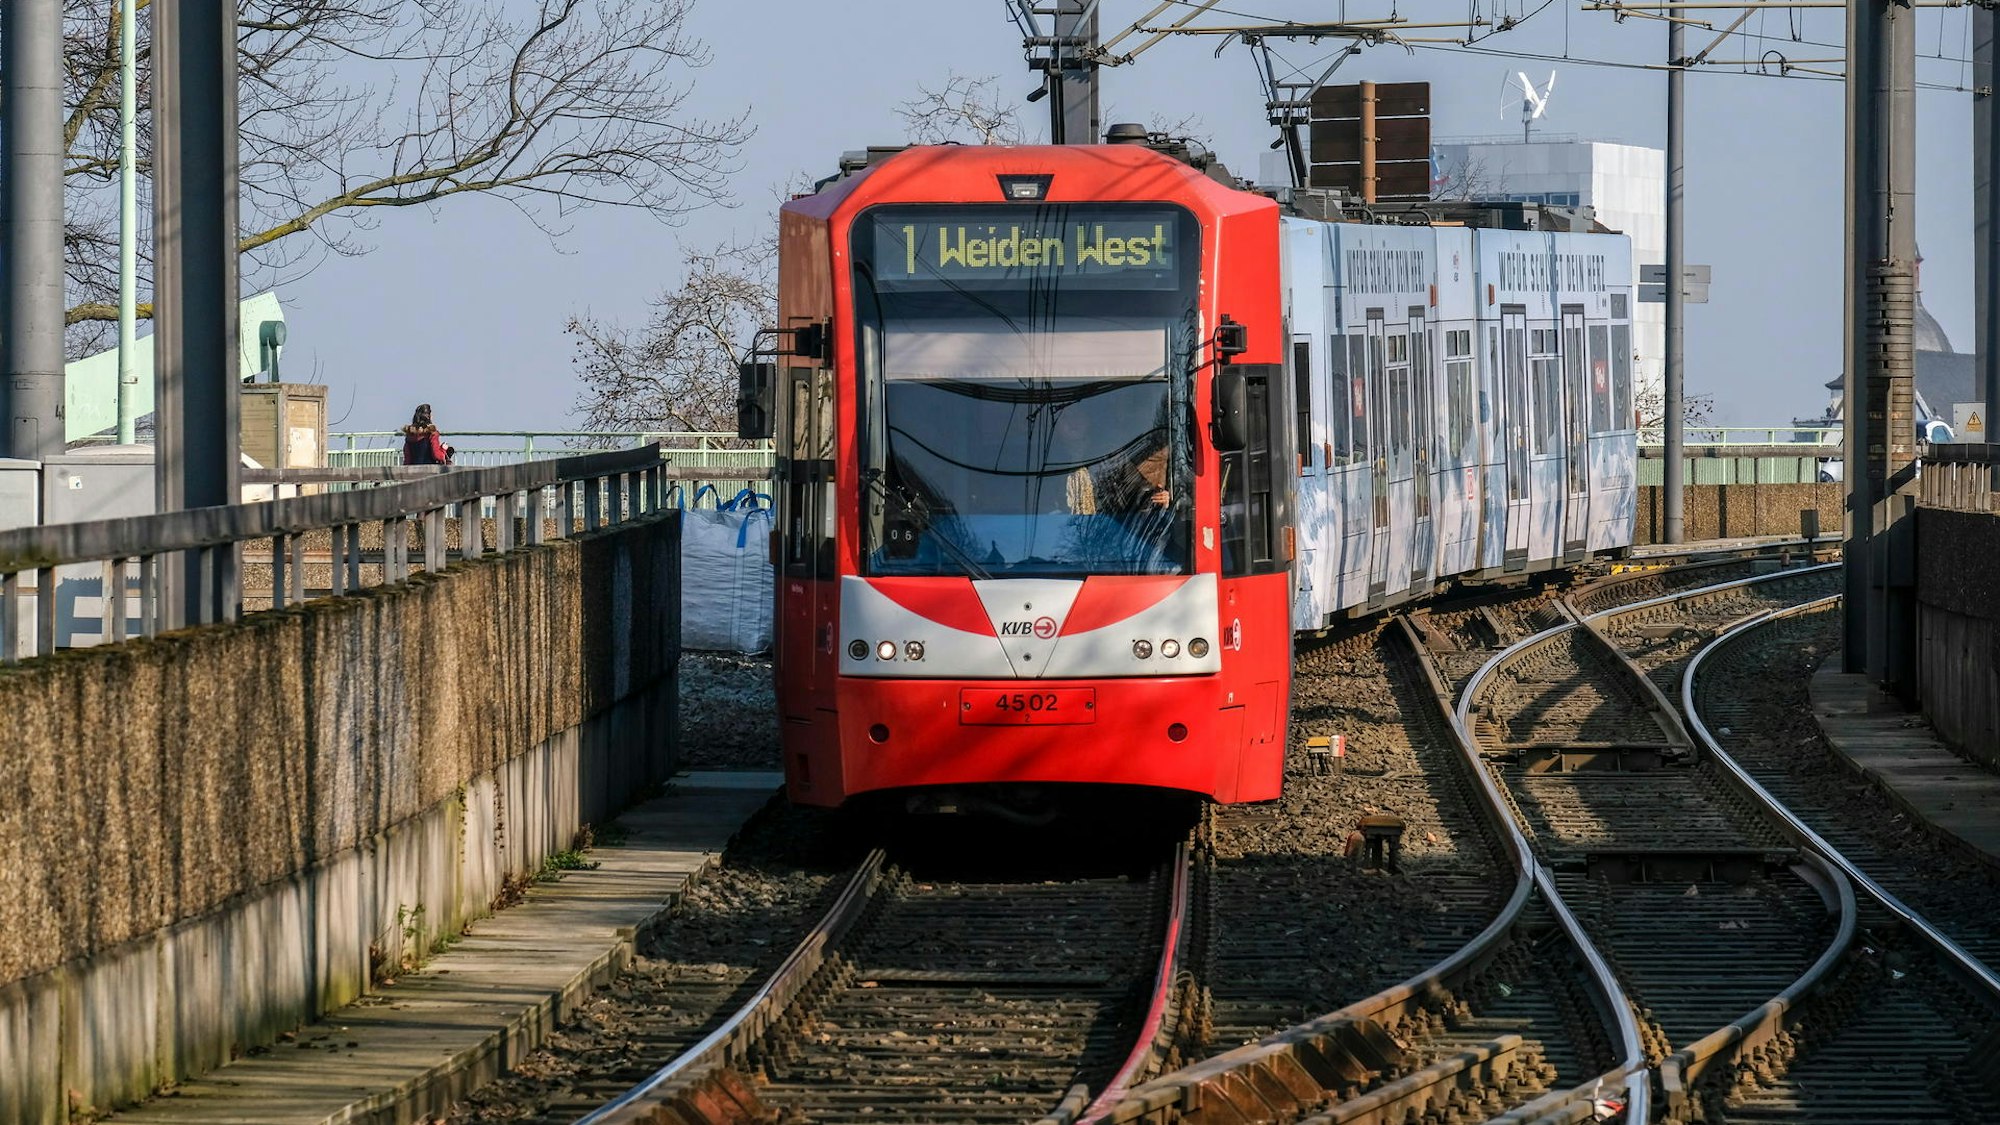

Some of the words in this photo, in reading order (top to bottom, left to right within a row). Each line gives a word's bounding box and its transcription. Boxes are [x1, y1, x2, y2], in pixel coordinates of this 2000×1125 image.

[902, 225, 916, 274] 1
[939, 225, 1066, 268] Weiden
[1076, 224, 1167, 267] West
[1566, 254, 1585, 292] DEIN
[1001, 621, 1033, 635] KVB
[995, 694, 1058, 711] 4502
[1024, 714, 1031, 723] 2
